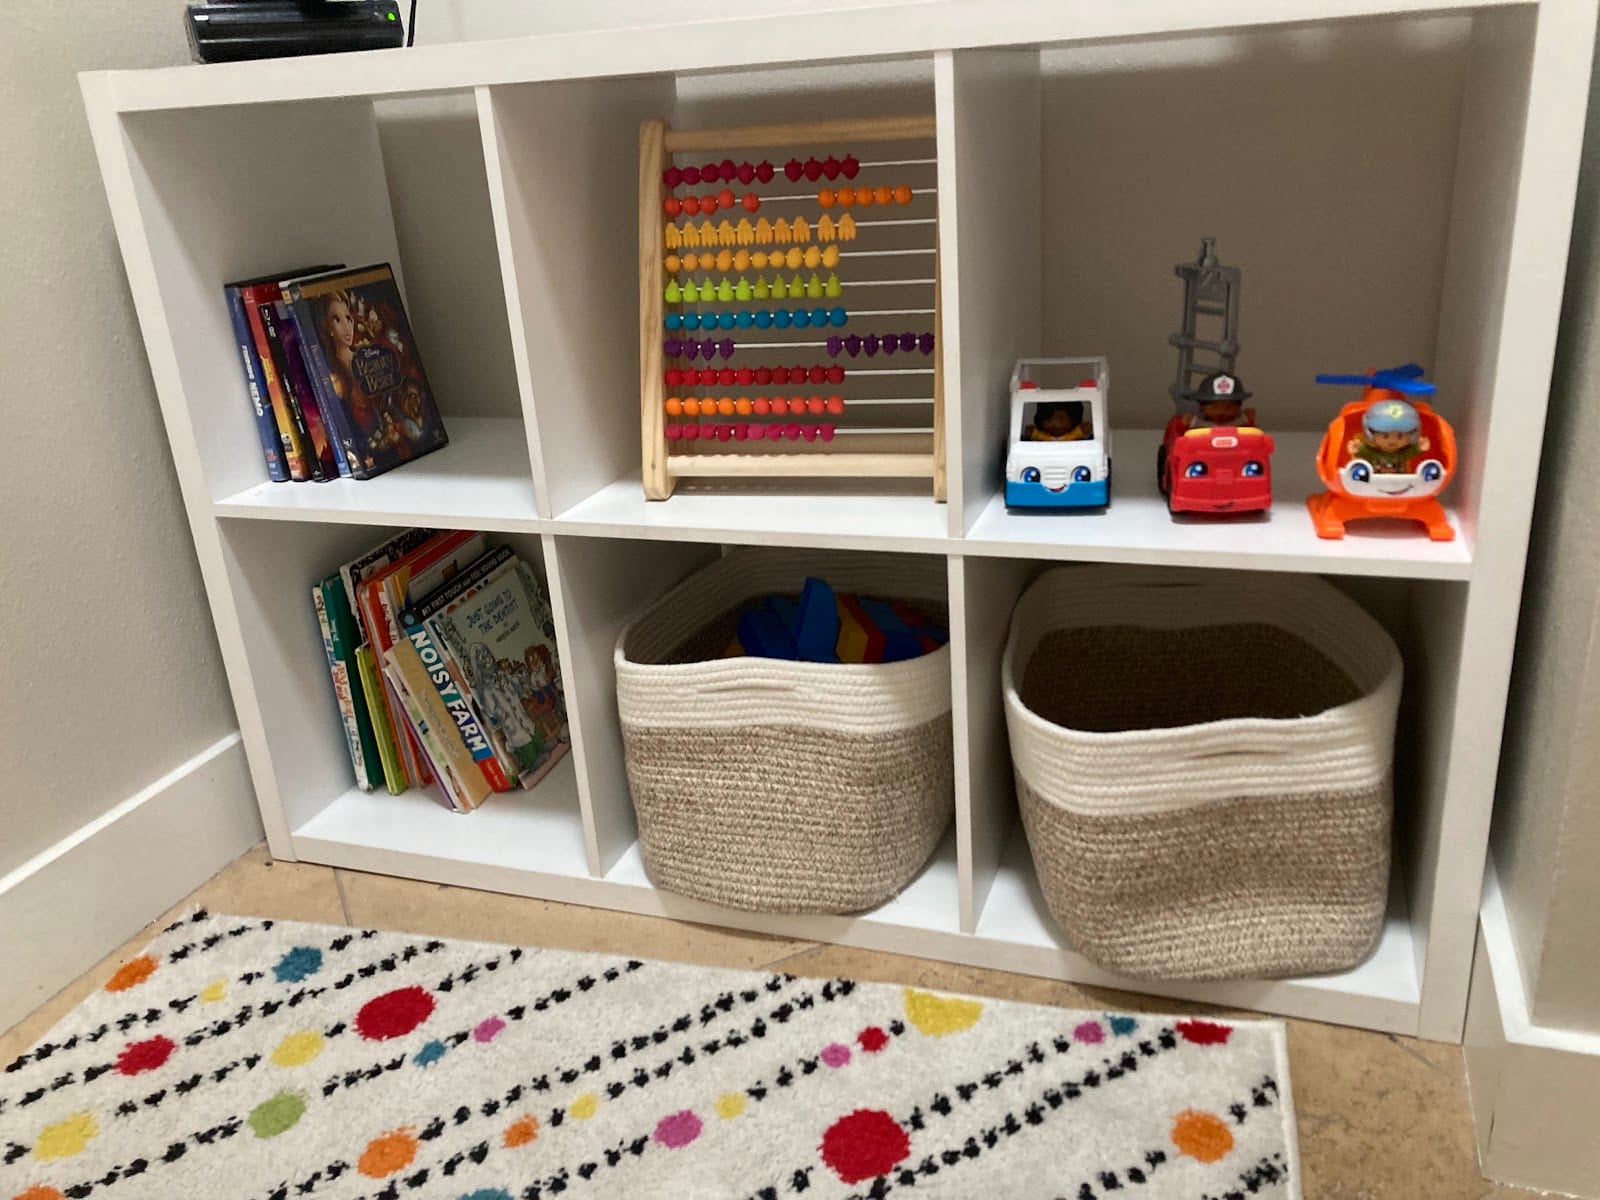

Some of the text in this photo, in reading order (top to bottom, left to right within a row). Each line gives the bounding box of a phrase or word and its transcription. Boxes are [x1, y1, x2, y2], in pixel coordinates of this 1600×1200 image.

[242, 345, 264, 417] FINDING NEMO
[421, 605, 432, 617] MY
[430, 595, 444, 608] FIRST
[444, 584, 461, 598] TOUCH
[470, 571, 481, 580] FEEL
[466, 588, 512, 628] JUST GOING TO
[478, 598, 519, 634] THE DENTIST
[411, 630, 458, 696] NOISY
[446, 699, 487, 751] FARM
